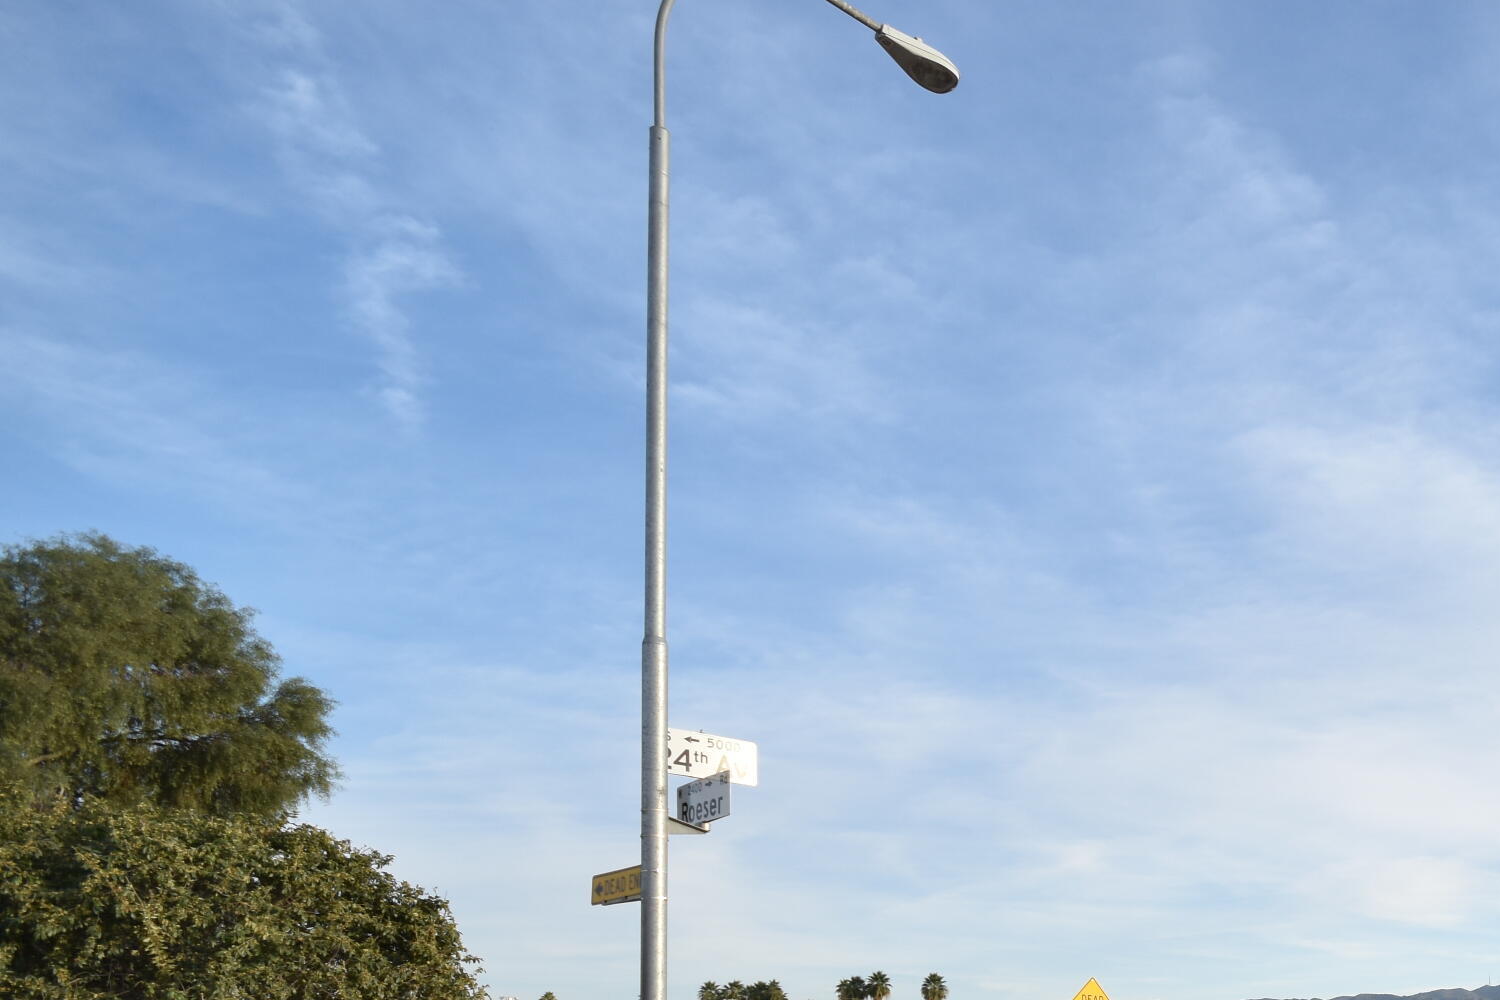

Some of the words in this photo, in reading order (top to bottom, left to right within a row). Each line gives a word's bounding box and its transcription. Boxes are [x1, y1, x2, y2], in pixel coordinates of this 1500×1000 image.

[667, 748, 708, 772] 4th
[681, 796, 723, 822] Roeser
[629, 873, 641, 890] EN
